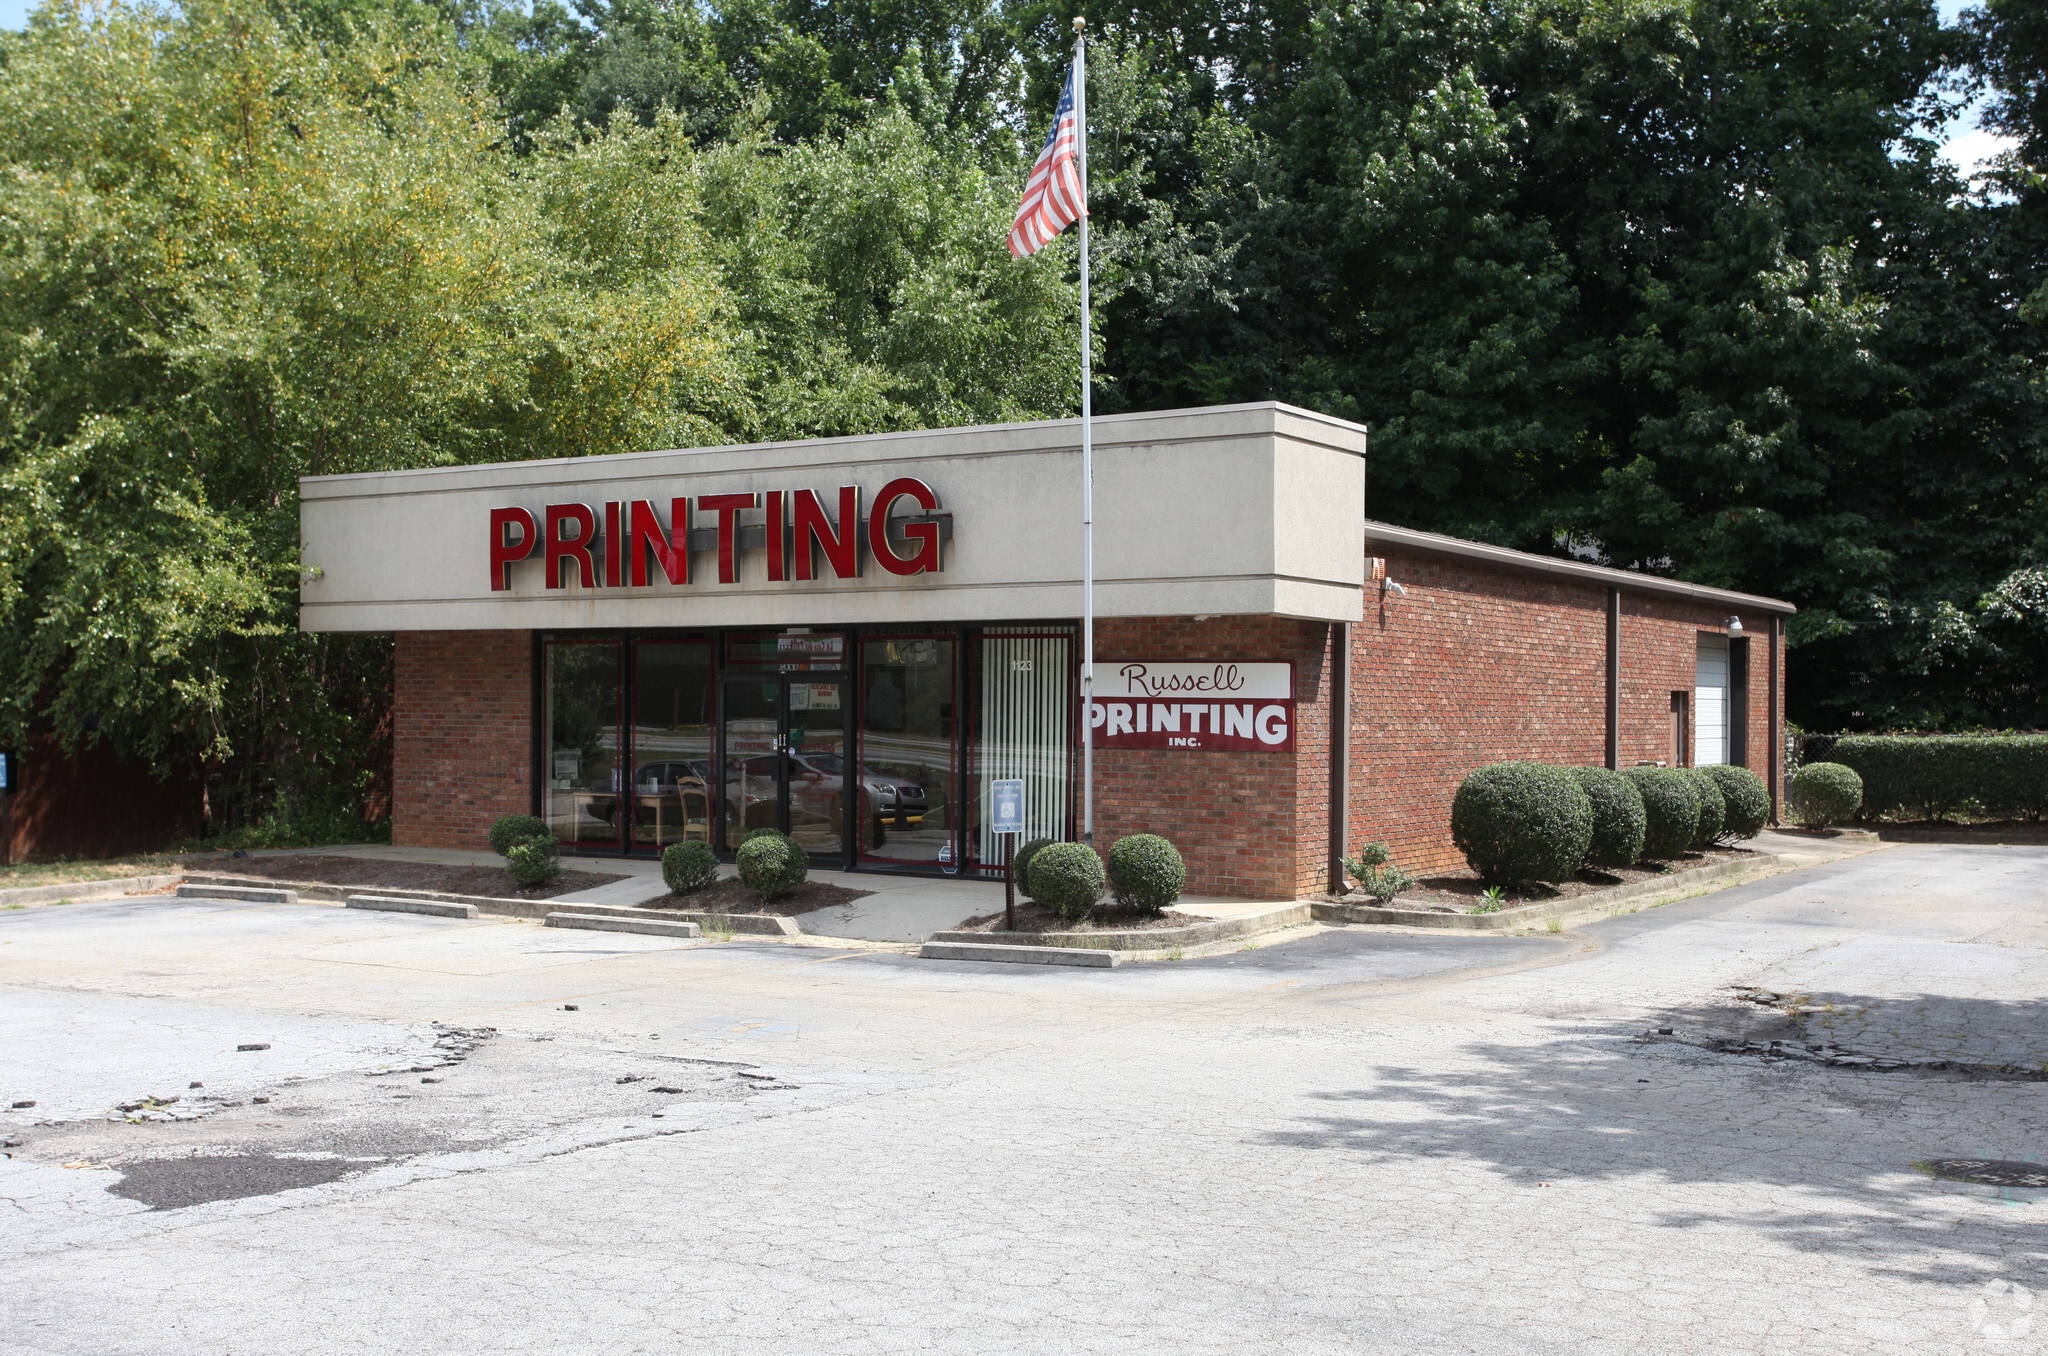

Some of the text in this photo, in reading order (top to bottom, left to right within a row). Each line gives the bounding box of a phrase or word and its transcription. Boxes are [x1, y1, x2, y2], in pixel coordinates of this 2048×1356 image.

[490, 477, 945, 592] PRINTING
[1012, 660, 1032, 671] 1123
[1119, 663, 1245, 697] Russell
[1082, 703, 1288, 745] PRINTING
[1168, 737, 1201, 747] INC.
